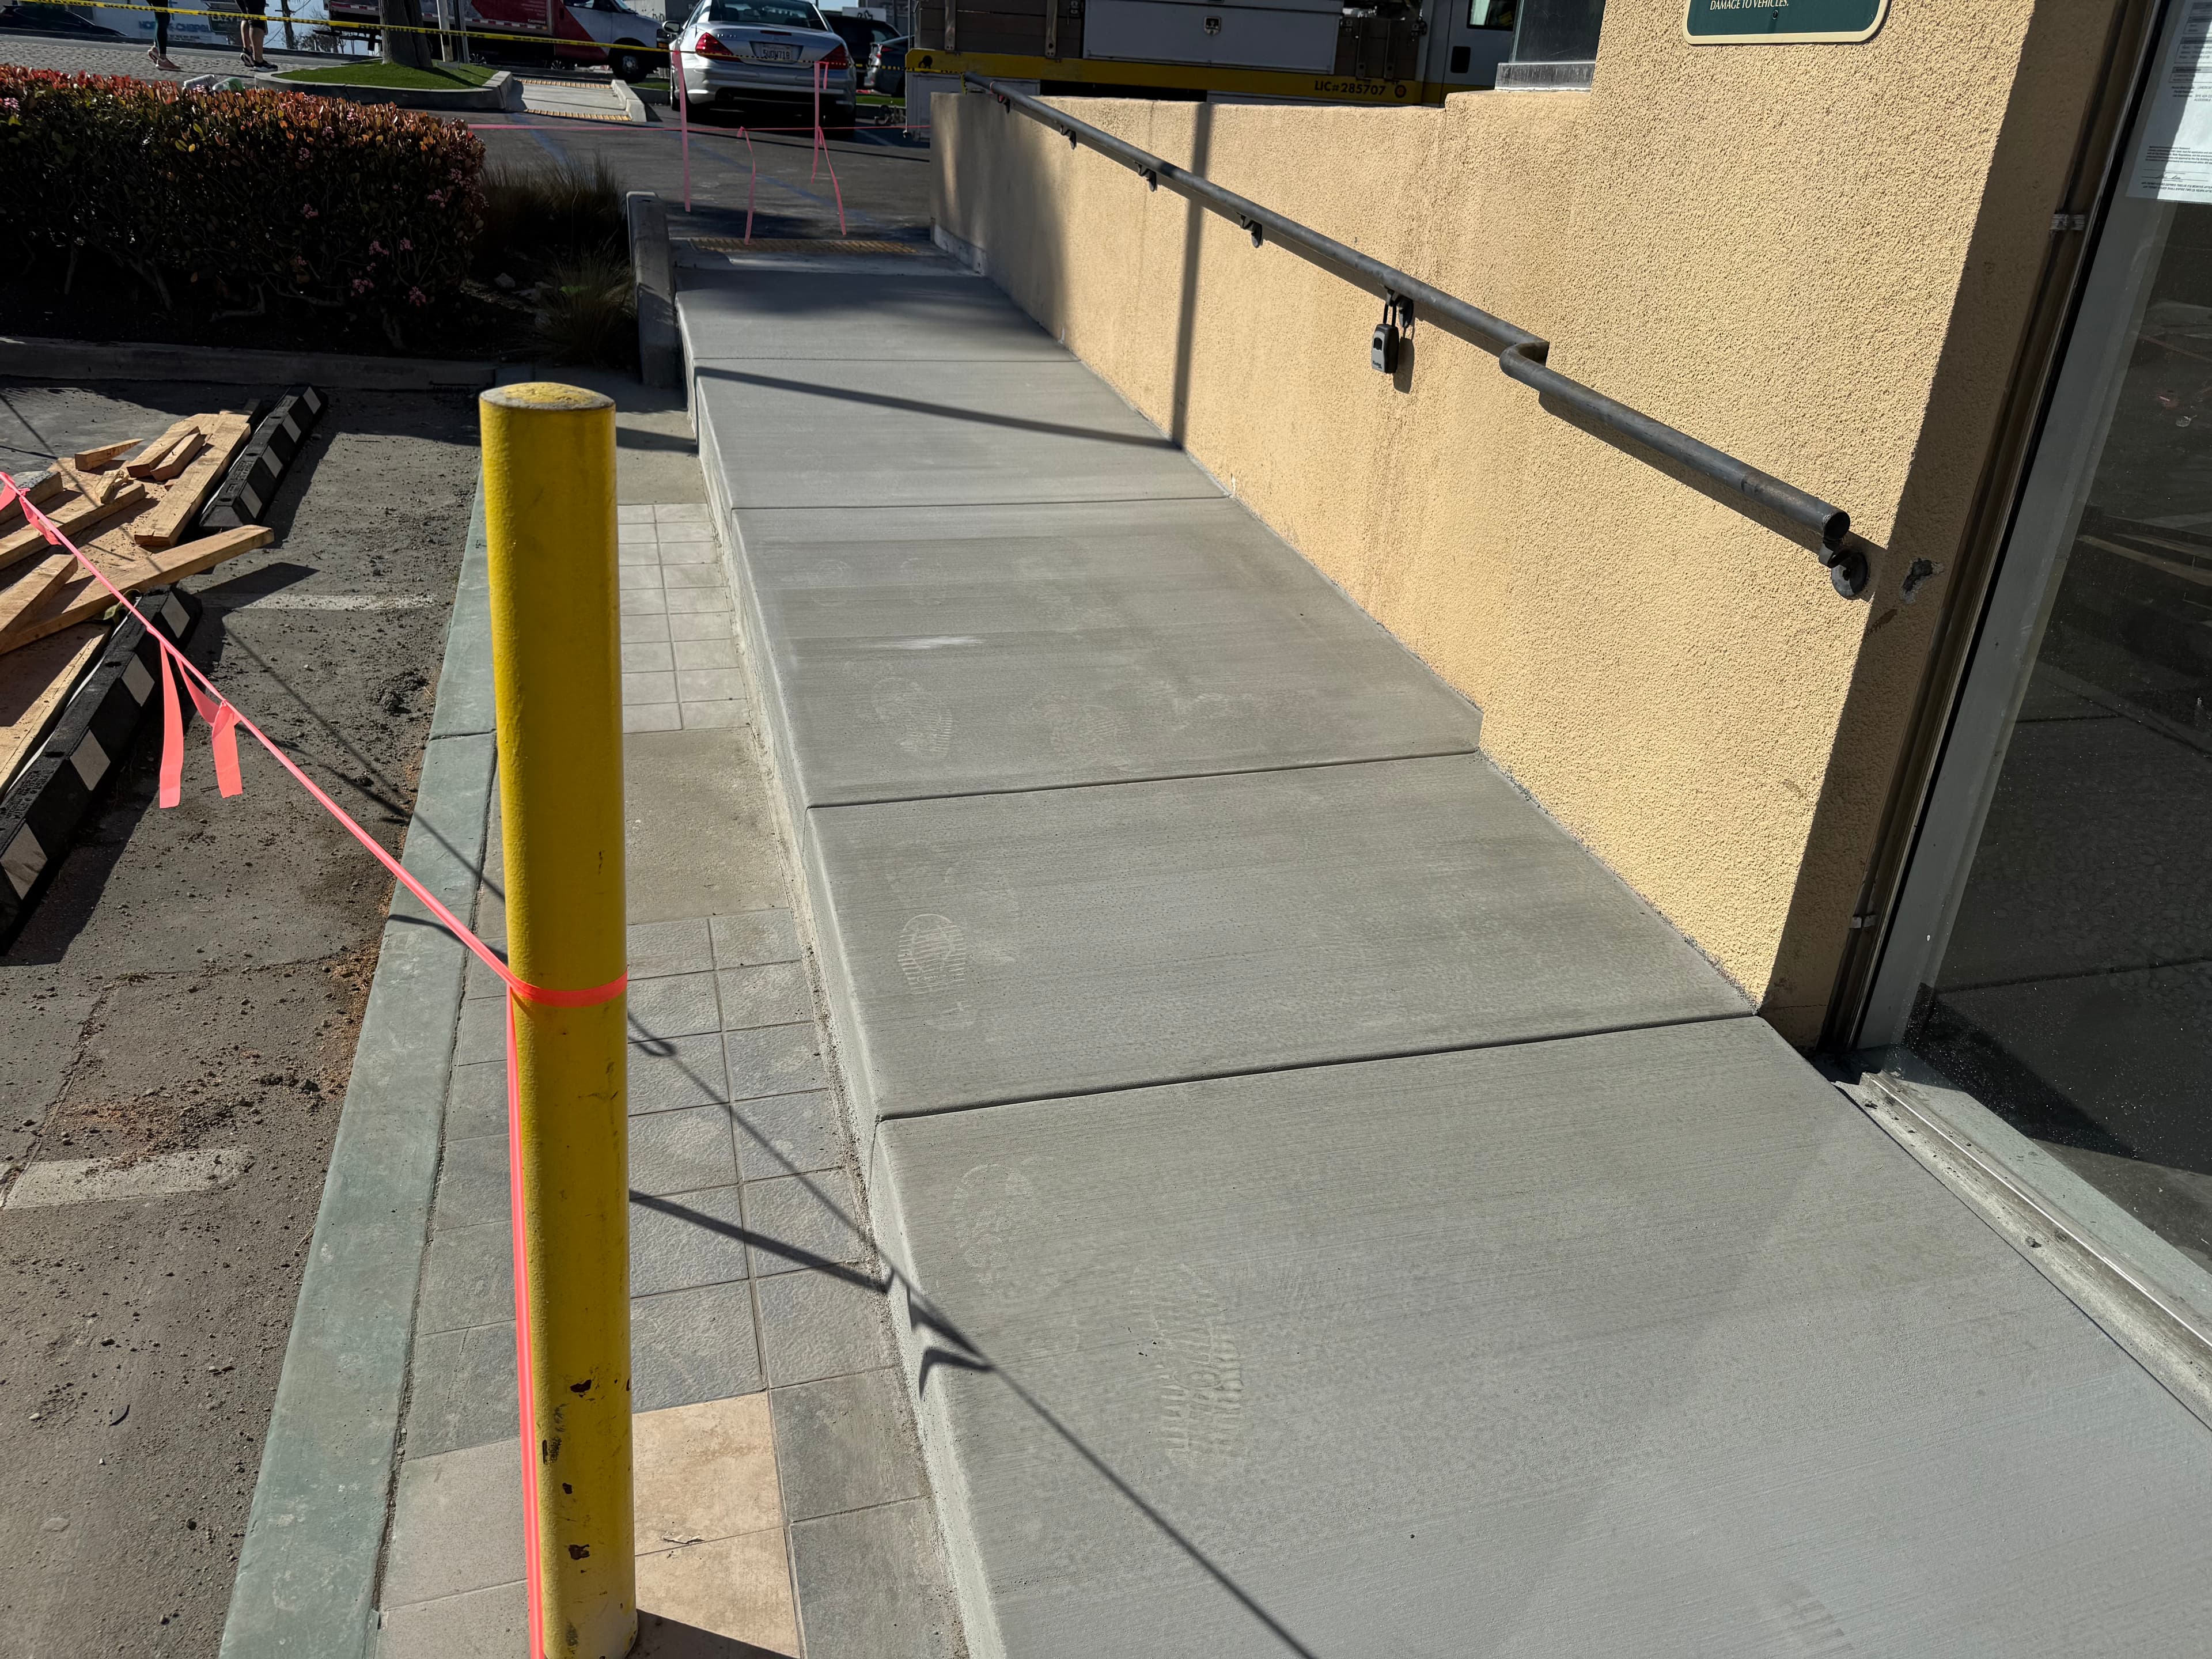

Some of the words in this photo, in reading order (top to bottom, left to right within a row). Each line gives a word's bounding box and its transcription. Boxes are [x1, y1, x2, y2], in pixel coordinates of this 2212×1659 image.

[1710, 0, 1740, 10] DAMAGE
[1741, 0, 1752, 9] TO
[1753, 0, 1789, 8] VEHICLES.
[1314, 80, 1386, 95] LIC#285707
